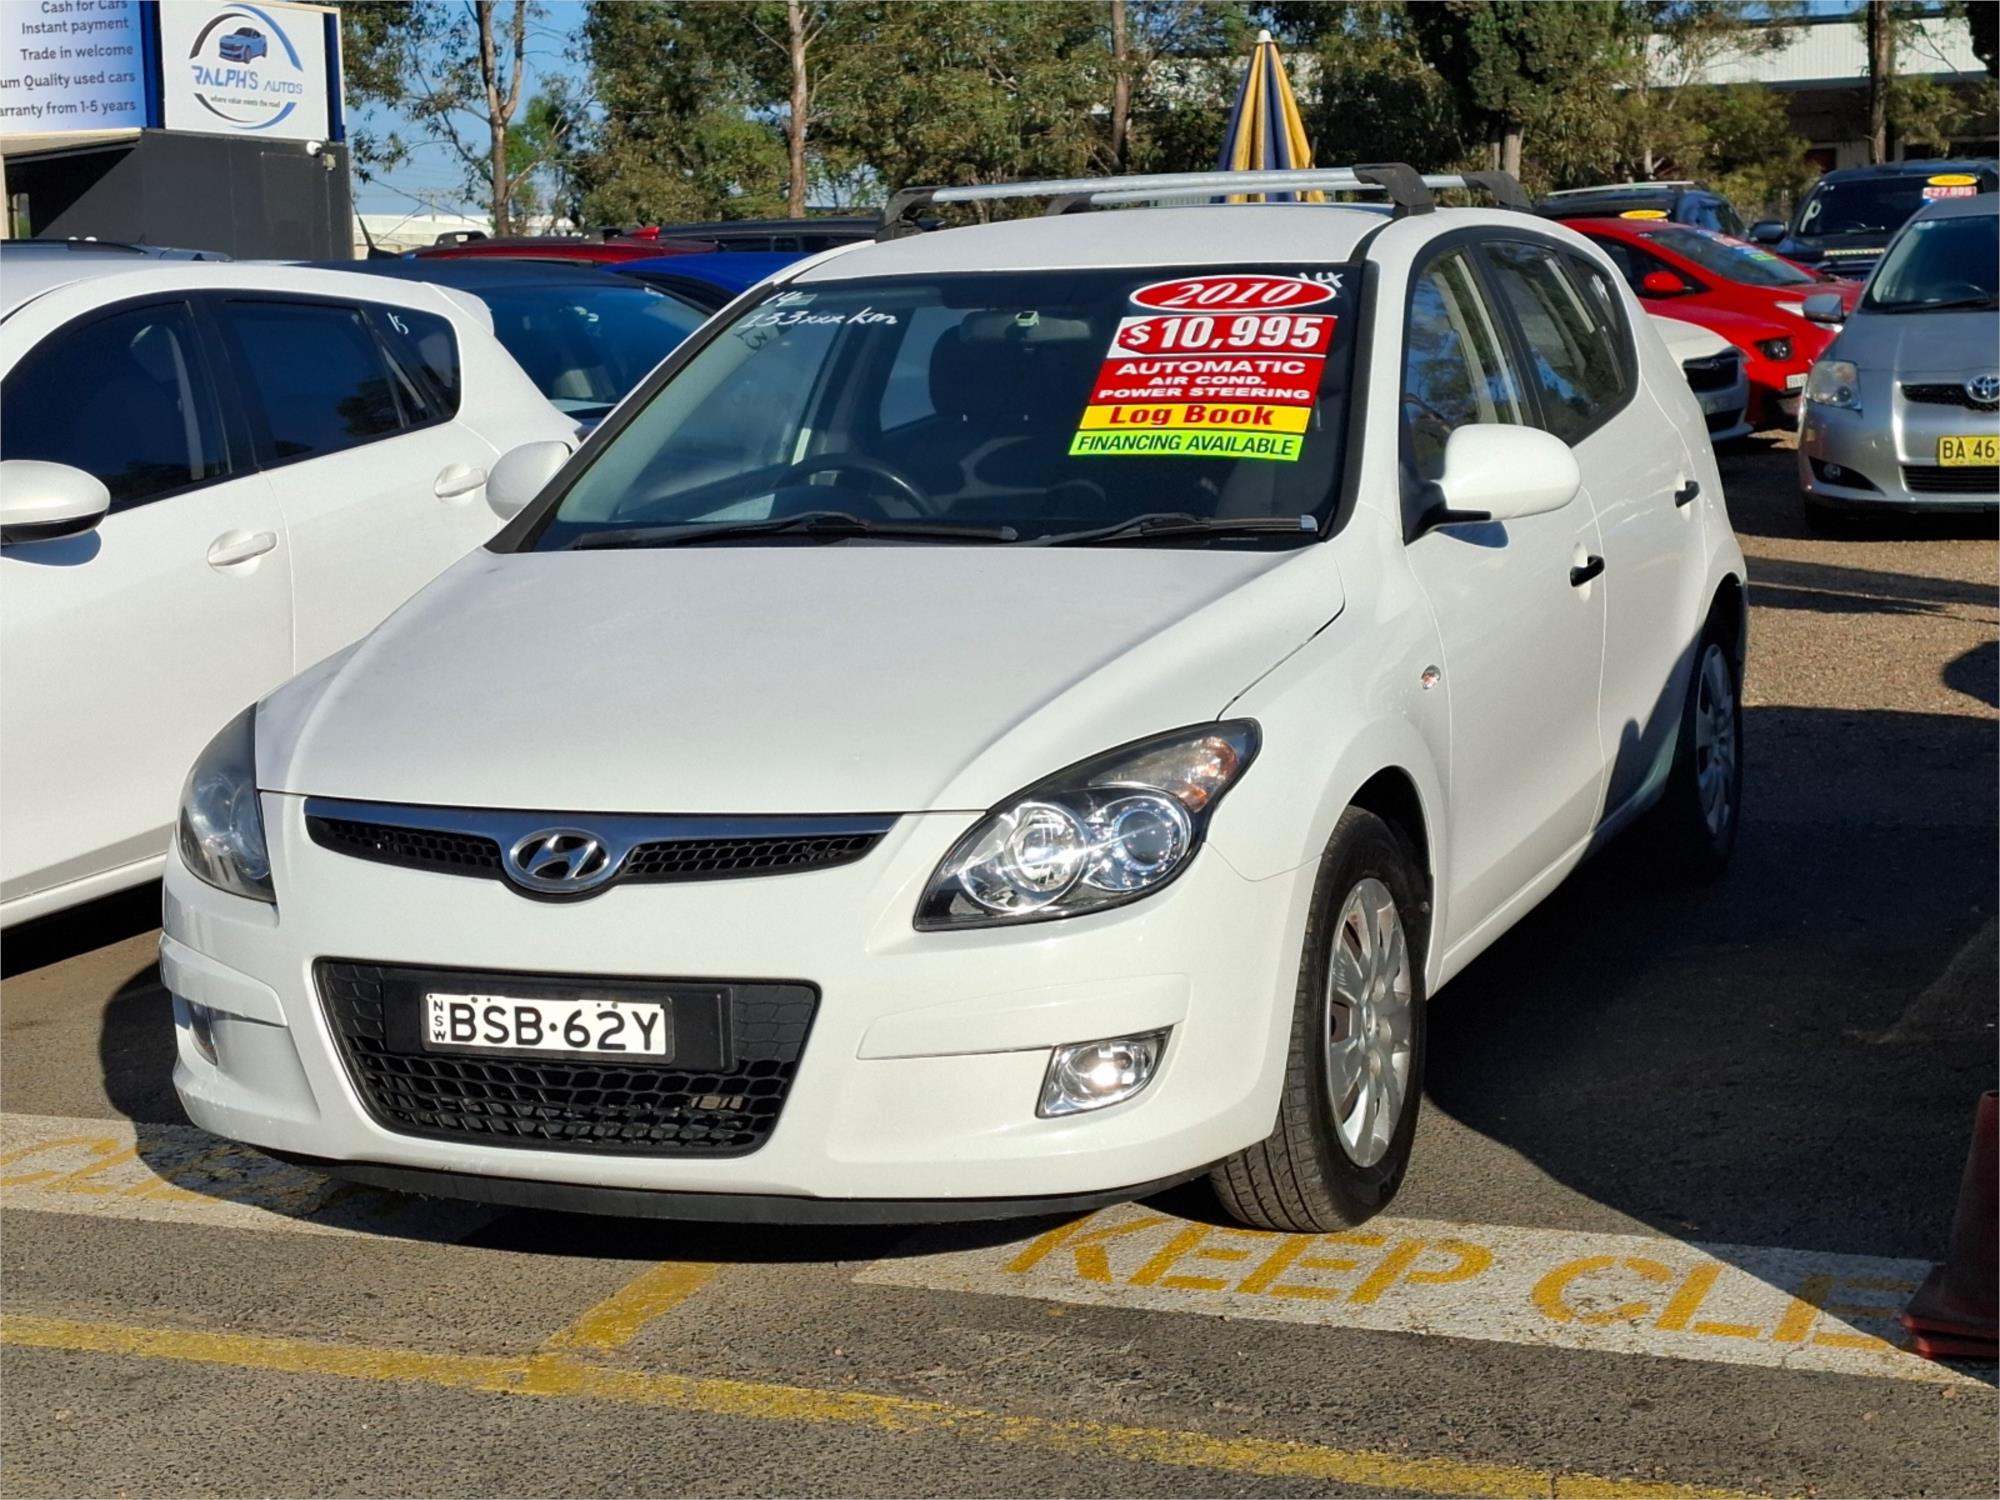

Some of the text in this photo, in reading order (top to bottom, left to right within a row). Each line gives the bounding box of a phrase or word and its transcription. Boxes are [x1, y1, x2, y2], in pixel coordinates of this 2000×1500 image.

[41, 0, 129, 13] Cash for Cars
[21, 17, 129, 34] Instant payment
[20, 44, 134, 61] Trade in welcome
[24, 72, 70, 91] Quality
[73, 70, 106, 85] used
[107, 72, 137, 83] cars
[263, 80, 304, 95] AUTOS
[46, 101, 78, 115] from
[80, 100, 98, 113] 1-5
[101, 100, 137, 116] years
[1159, 281, 1302, 305] 2010
[1115, 360, 1306, 376] AUTOMATIC
[1147, 375, 1267, 386] AIR COND.
[1098, 387, 1311, 400] POWER STEERING
[1108, 405, 1274, 426] Log Book
[1077, 434, 1294, 457] FINANCING AVAILABLE
[1942, 439, 1966, 460] BA
[1004, 1205, 1494, 1304] KEEP
